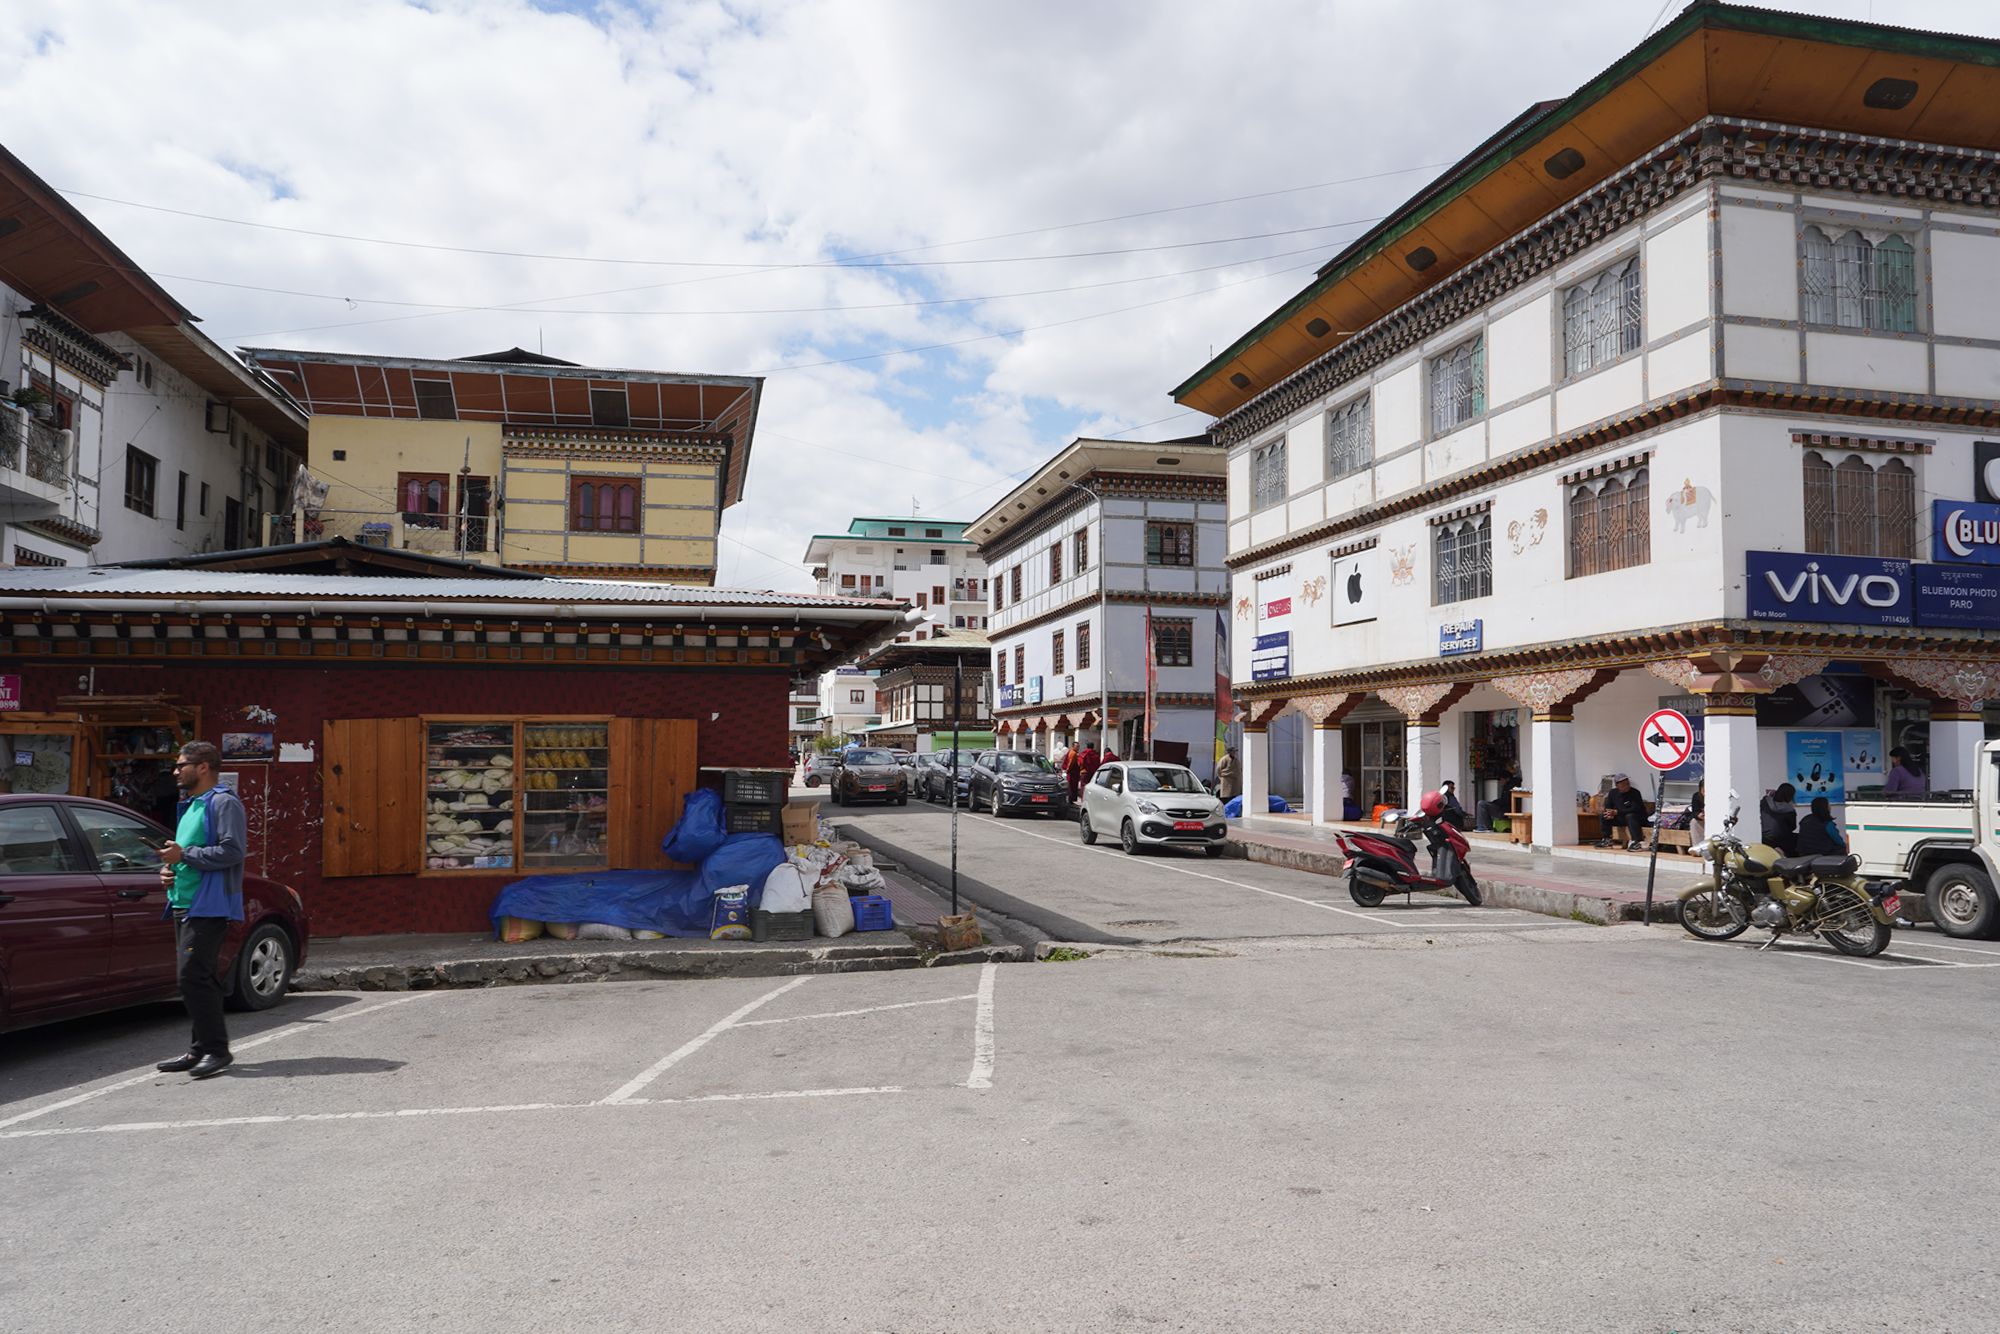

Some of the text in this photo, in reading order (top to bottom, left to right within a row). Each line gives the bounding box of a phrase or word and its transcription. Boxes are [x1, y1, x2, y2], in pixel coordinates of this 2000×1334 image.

[1960, 519, 2000, 545] BLU
[1764, 562, 1900, 607] vivo
[1921, 586, 1998, 598] BLUEMOON PHOTO
[1950, 599, 1973, 609] PARO
[1443, 621, 1476, 635] REPAIR
[1440, 637, 1477, 651] SERVICES
